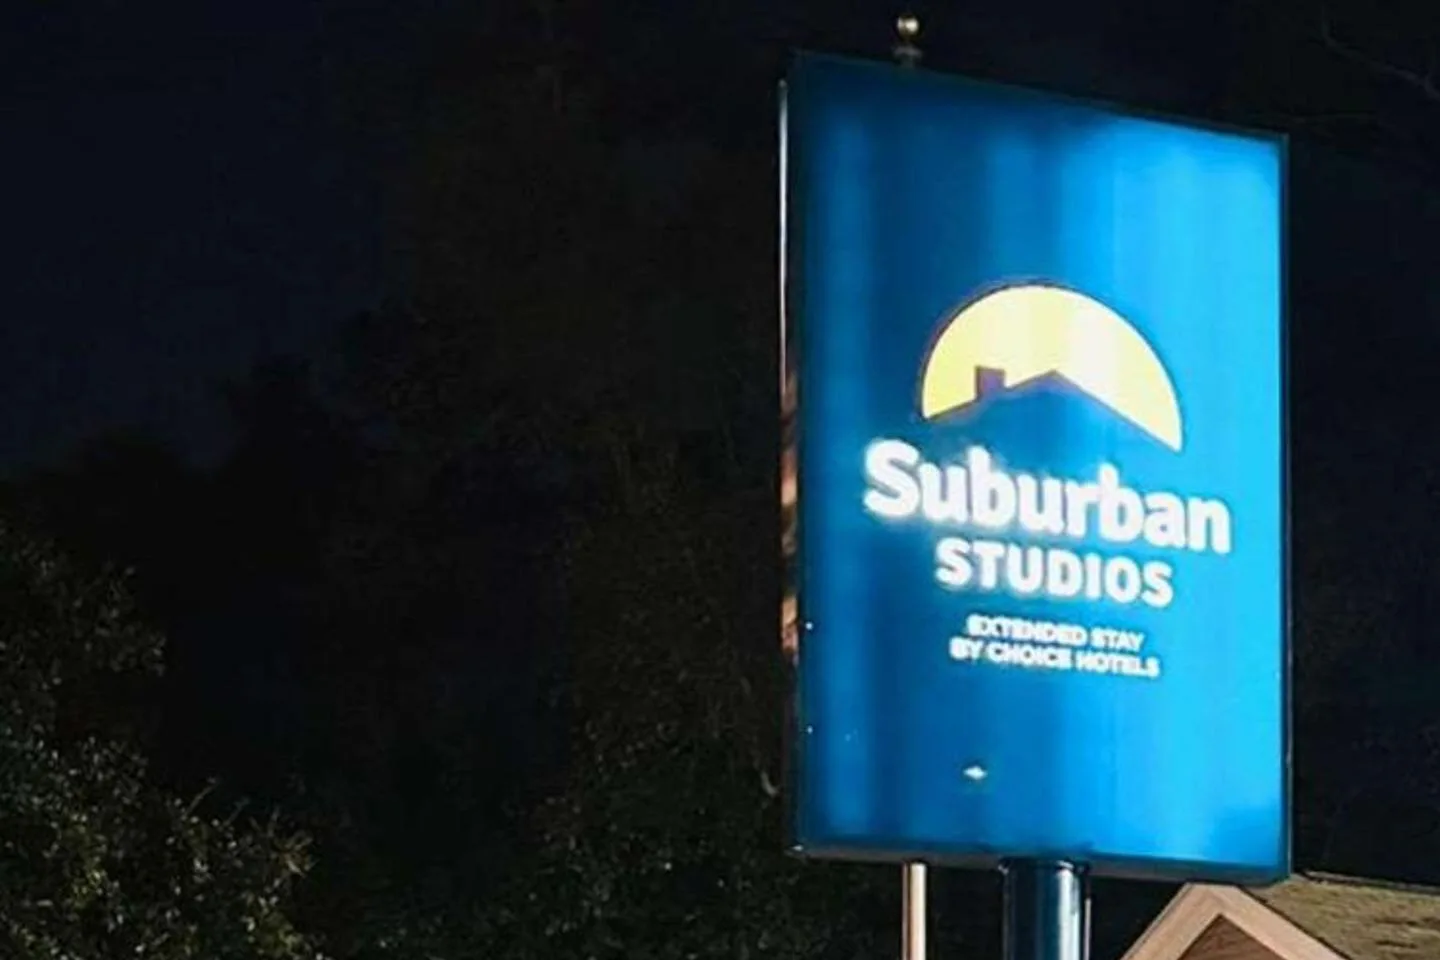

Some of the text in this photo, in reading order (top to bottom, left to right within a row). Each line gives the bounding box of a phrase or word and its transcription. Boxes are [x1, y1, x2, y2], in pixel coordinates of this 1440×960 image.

[863, 439, 1231, 553] Suburban
[934, 537, 1174, 608] STUDIOS
[949, 637, 1161, 679] BY CHOICE HOTELS
[966, 614, 1146, 651] EXTENDED STAY
